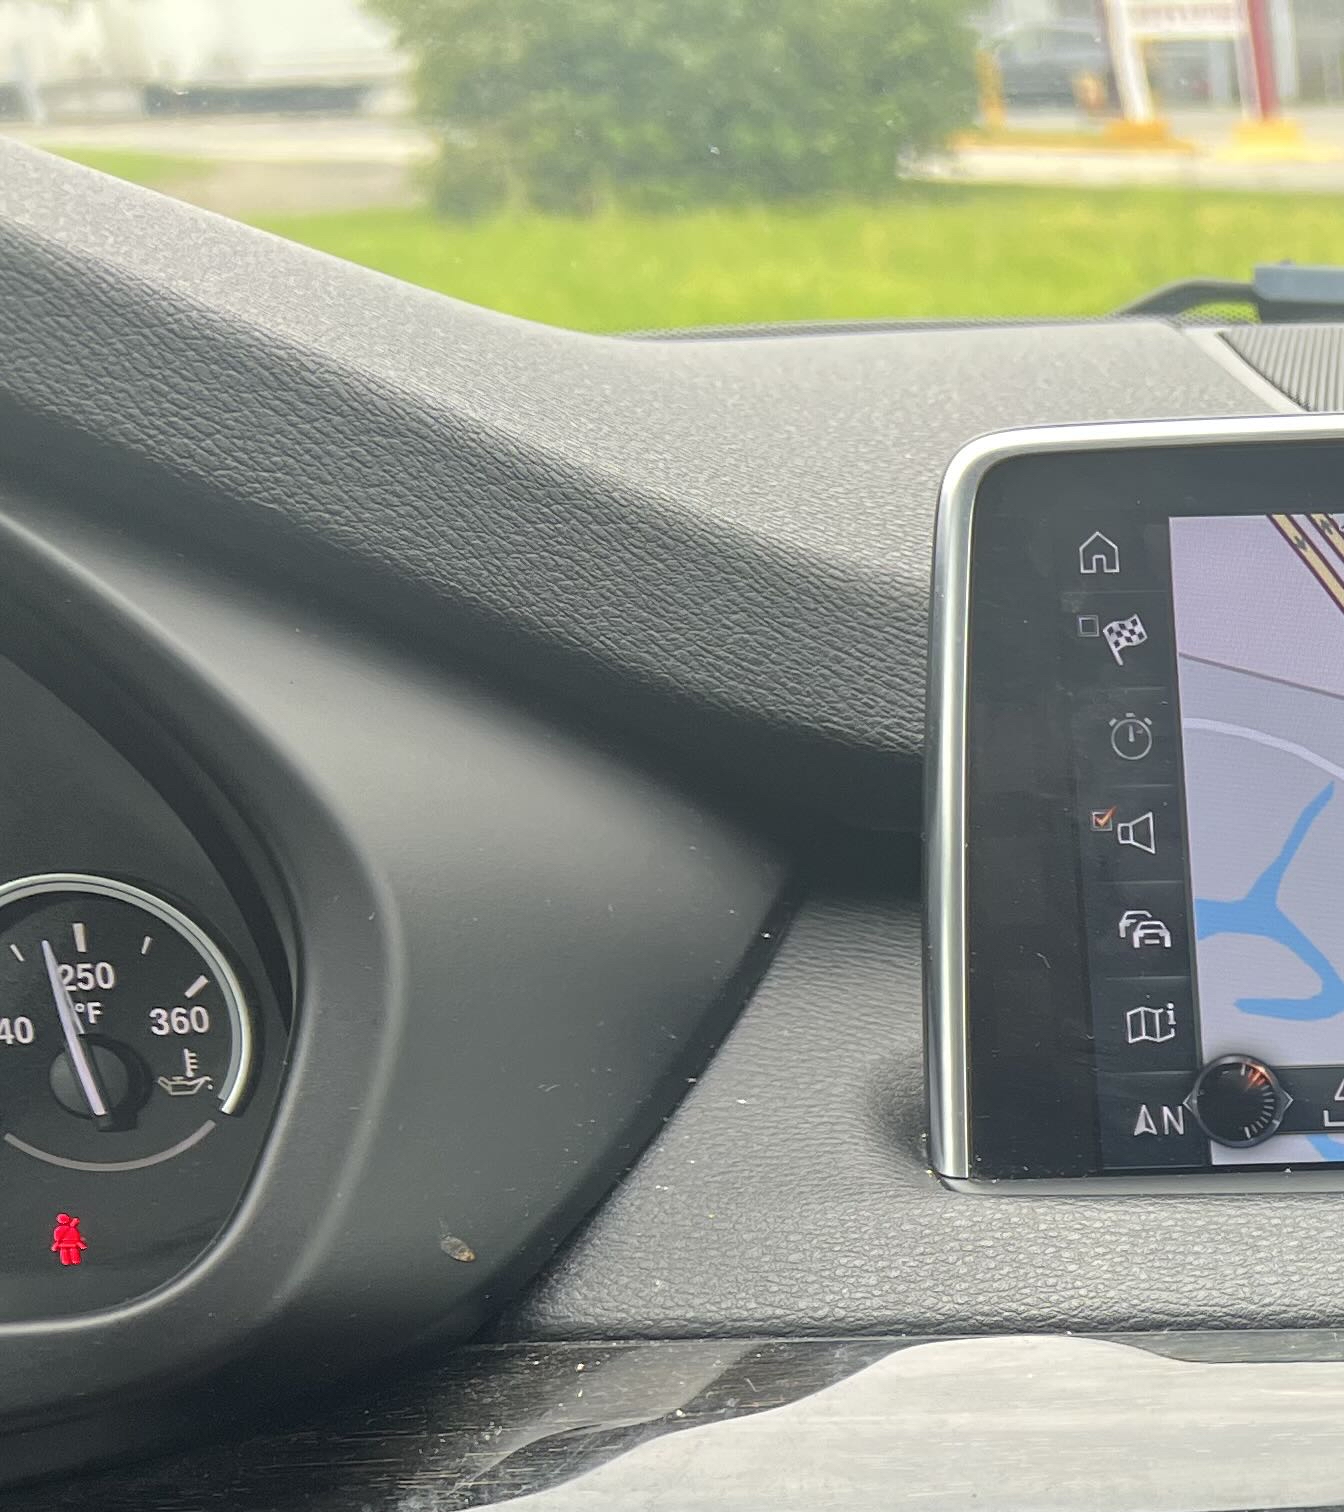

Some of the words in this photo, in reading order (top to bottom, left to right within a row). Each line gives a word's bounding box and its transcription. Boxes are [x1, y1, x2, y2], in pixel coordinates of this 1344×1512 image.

[57, 962, 116, 992] 250
[149, 1006, 209, 1036] 360
[1162, 1106, 1184, 1135] N
